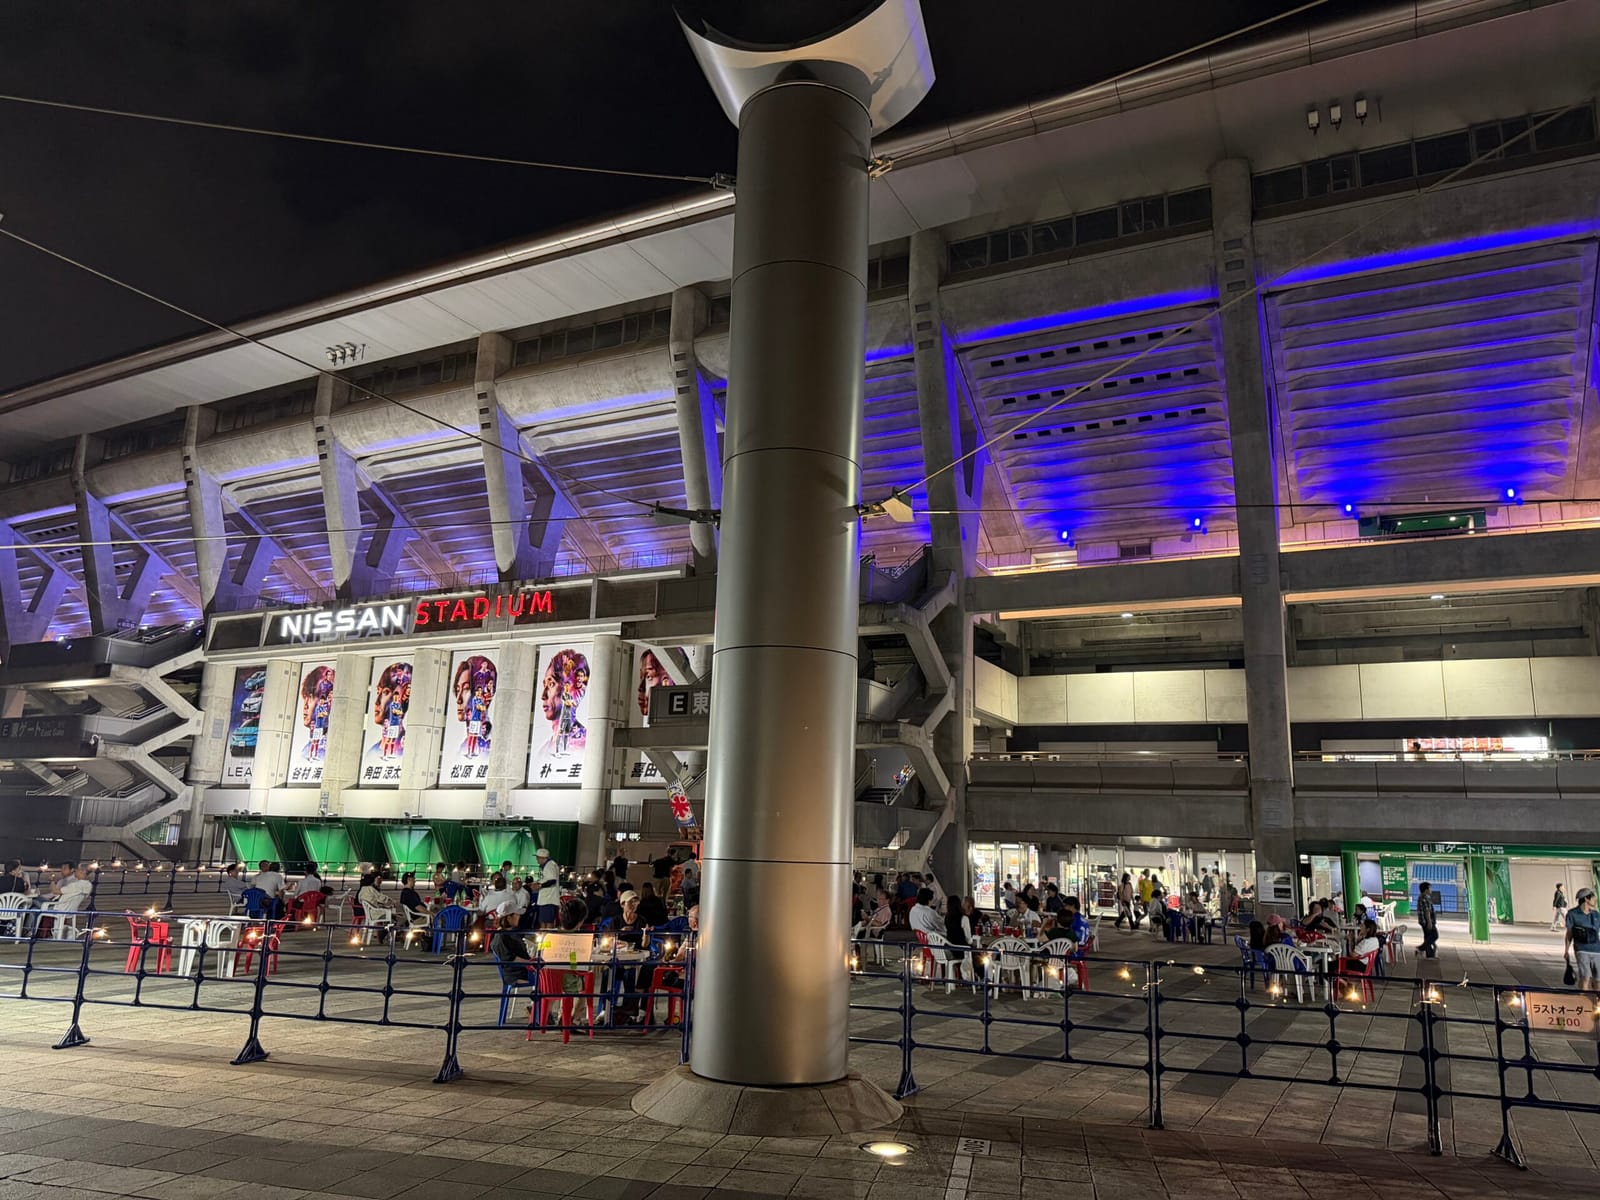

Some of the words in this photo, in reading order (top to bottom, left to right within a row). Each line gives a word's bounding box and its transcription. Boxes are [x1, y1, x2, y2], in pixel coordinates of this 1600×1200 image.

[280, 604, 405, 637] NISSAN
[414, 591, 553, 626] STADIUM
[673, 694, 684, 712] E
[692, 690, 709, 715] 東
[1435, 843, 1476, 854] 東ゲート
[1533, 1004, 1593, 1016] ラストオーダー
[1548, 1017, 1581, 1027] 21:00
